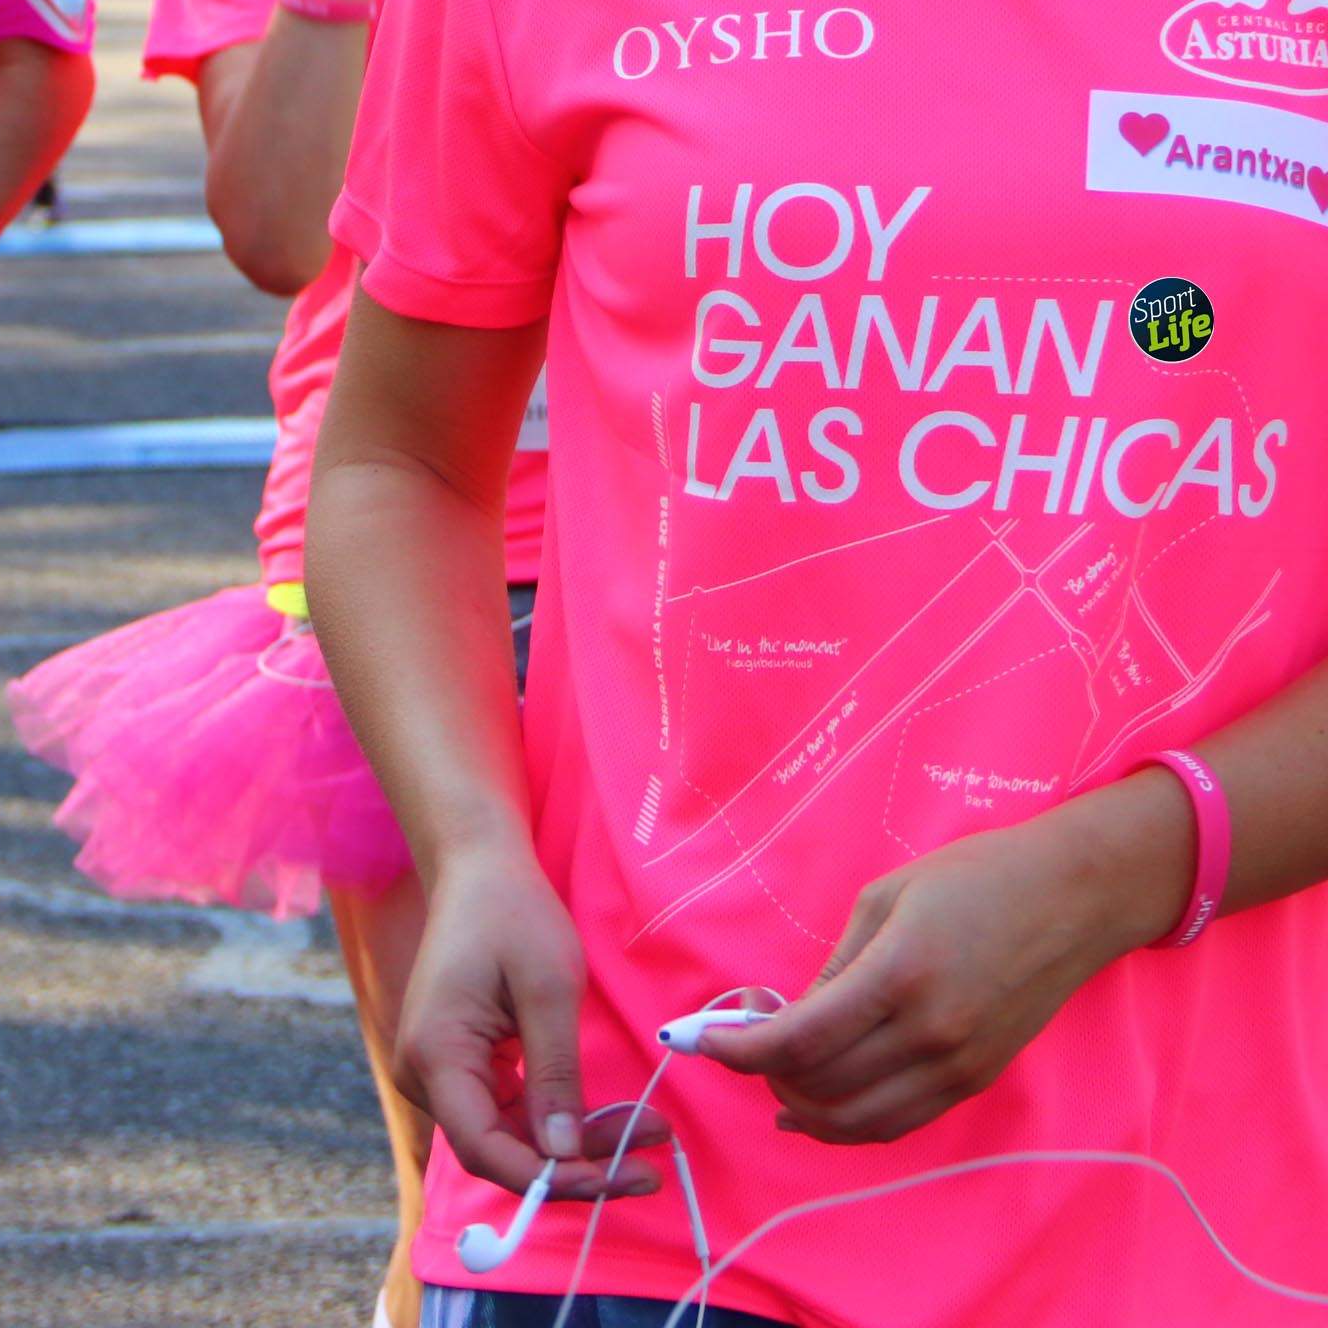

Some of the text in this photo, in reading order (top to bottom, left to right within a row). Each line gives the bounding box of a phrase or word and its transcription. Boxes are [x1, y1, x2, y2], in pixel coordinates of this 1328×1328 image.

[613, 7, 875, 80] OYSHO
[1217, 15, 1289, 32] CENTRAL
[1164, 133, 1307, 189] Arantxa
[683, 182, 932, 282] HOY
[1133, 286, 1197, 324] Sport
[1147, 309, 1212, 352] Life
[692, 290, 1114, 397] GANAN
[683, 403, 1288, 519] LAS CHICAS
[654, 559, 667, 617] MUJER
[652, 621, 662, 644] LA
[653, 647, 663, 669] DE
[656, 673, 669, 751] CARRERA
[964, 767, 984, 792] for
